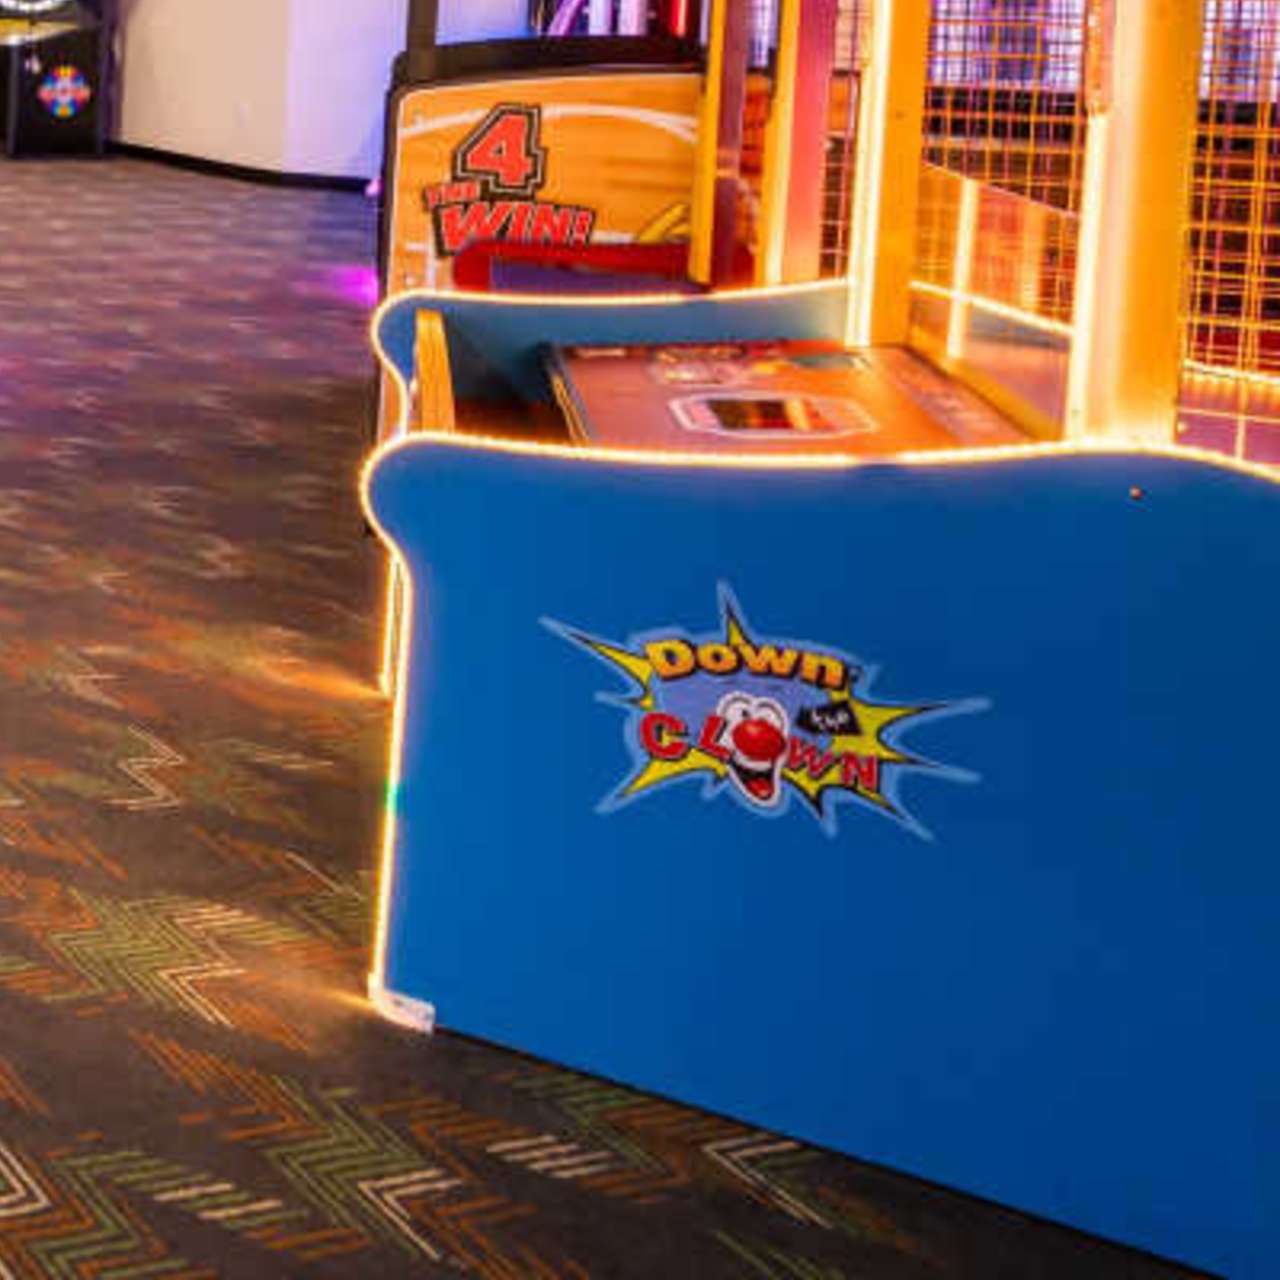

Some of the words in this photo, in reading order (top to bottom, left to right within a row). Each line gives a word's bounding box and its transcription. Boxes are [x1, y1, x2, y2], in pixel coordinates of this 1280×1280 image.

[458, 106, 544, 194] 4
[437, 201, 595, 253] WIN!
[645, 638, 848, 691] Down
